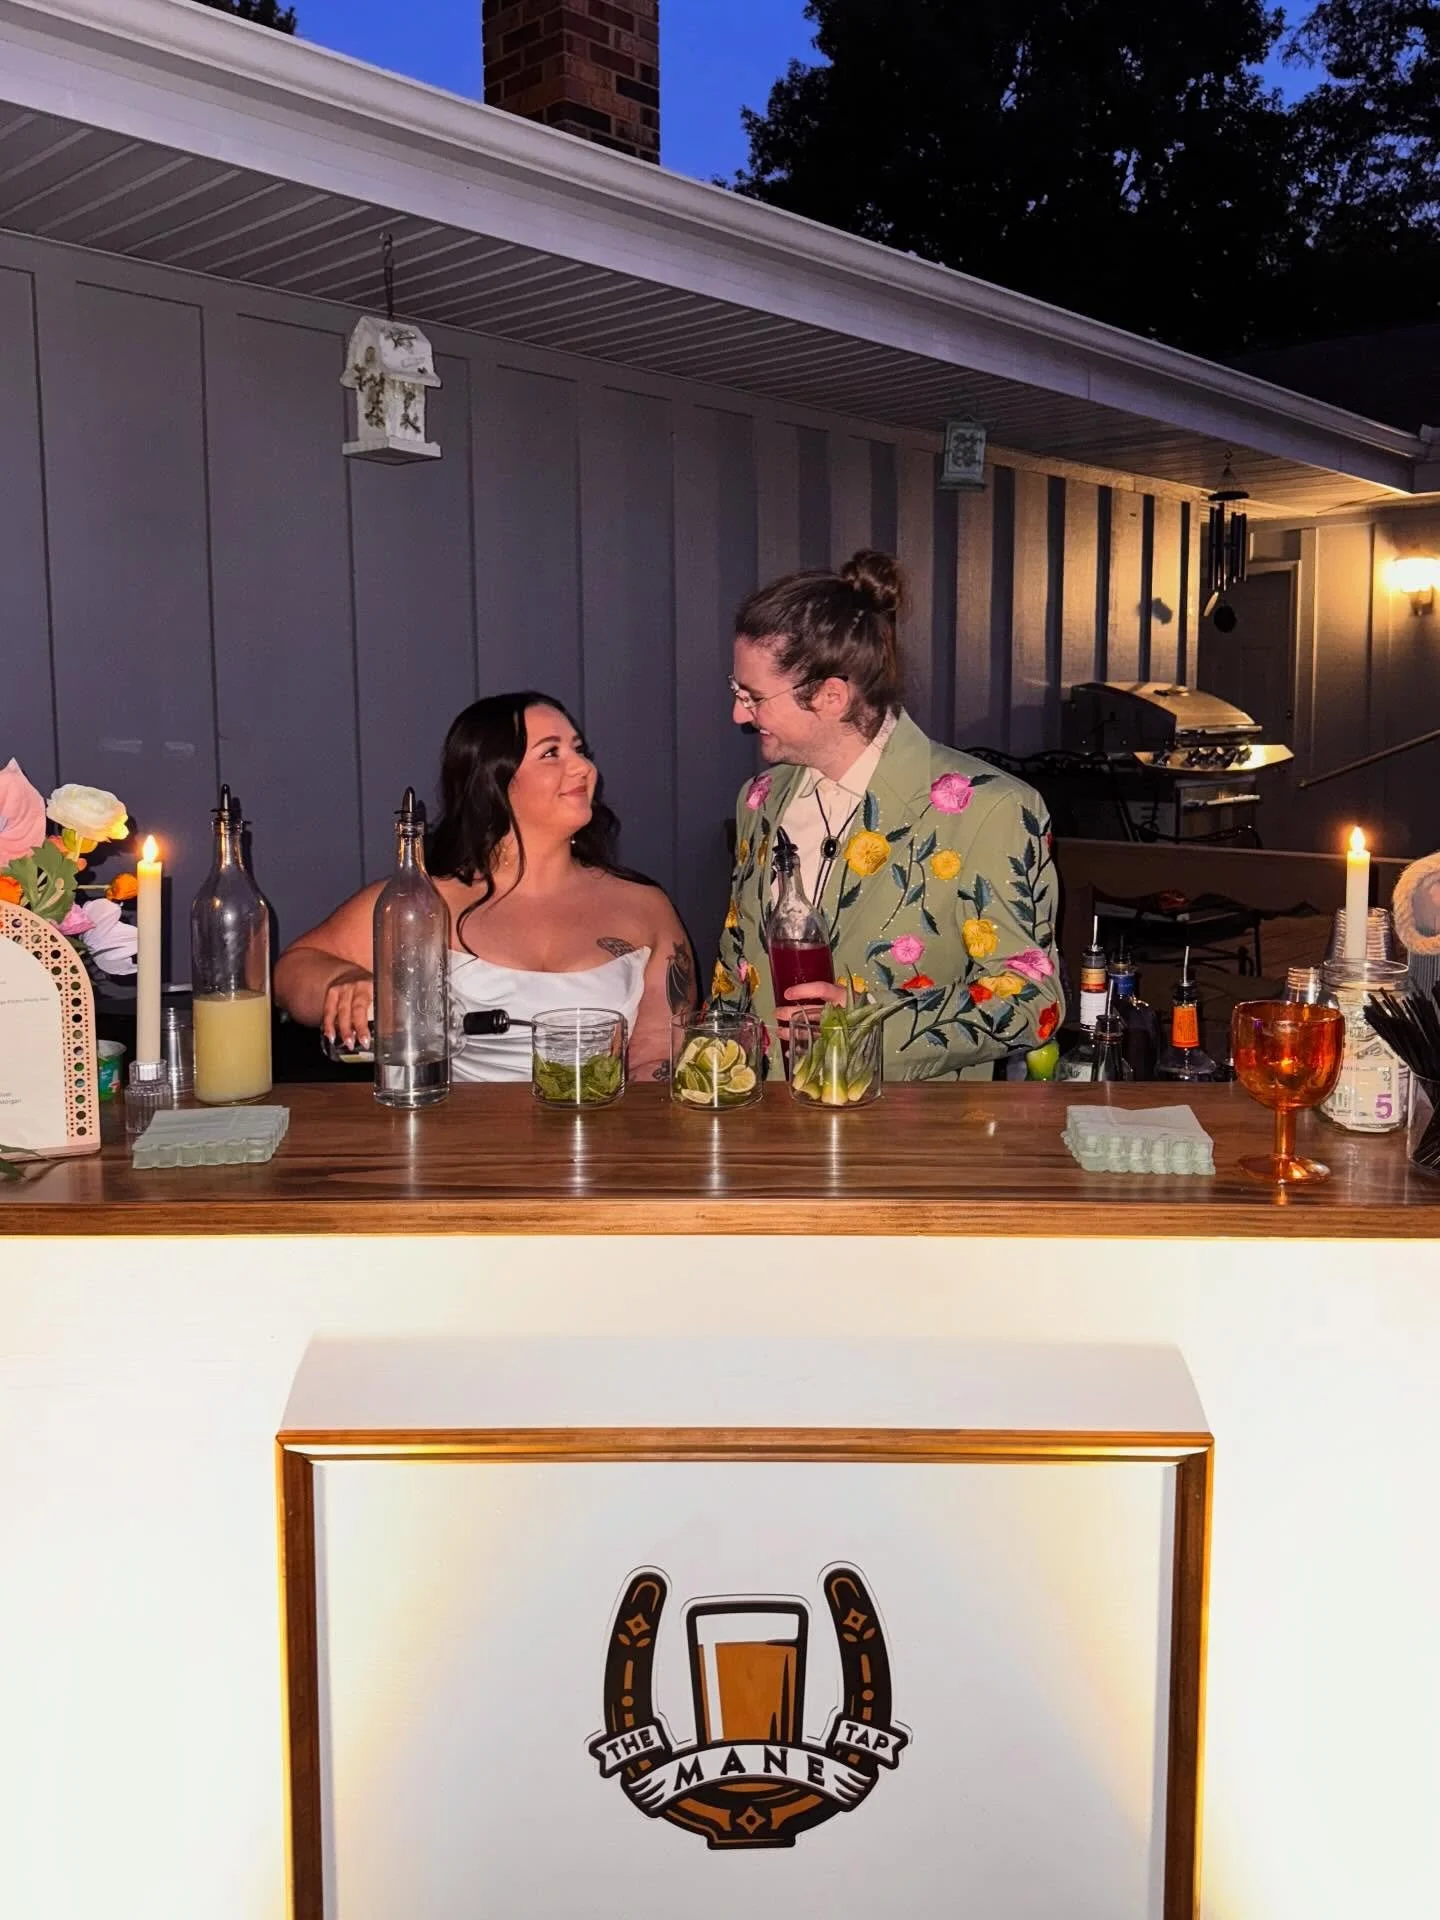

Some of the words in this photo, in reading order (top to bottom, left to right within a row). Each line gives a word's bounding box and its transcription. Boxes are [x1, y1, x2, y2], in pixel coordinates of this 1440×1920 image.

[1375, 1093, 1393, 1120] 5
[606, 1729, 652, 1761] THE
[846, 1724, 890, 1752] TAP
[674, 1746, 825, 1791] MANE
